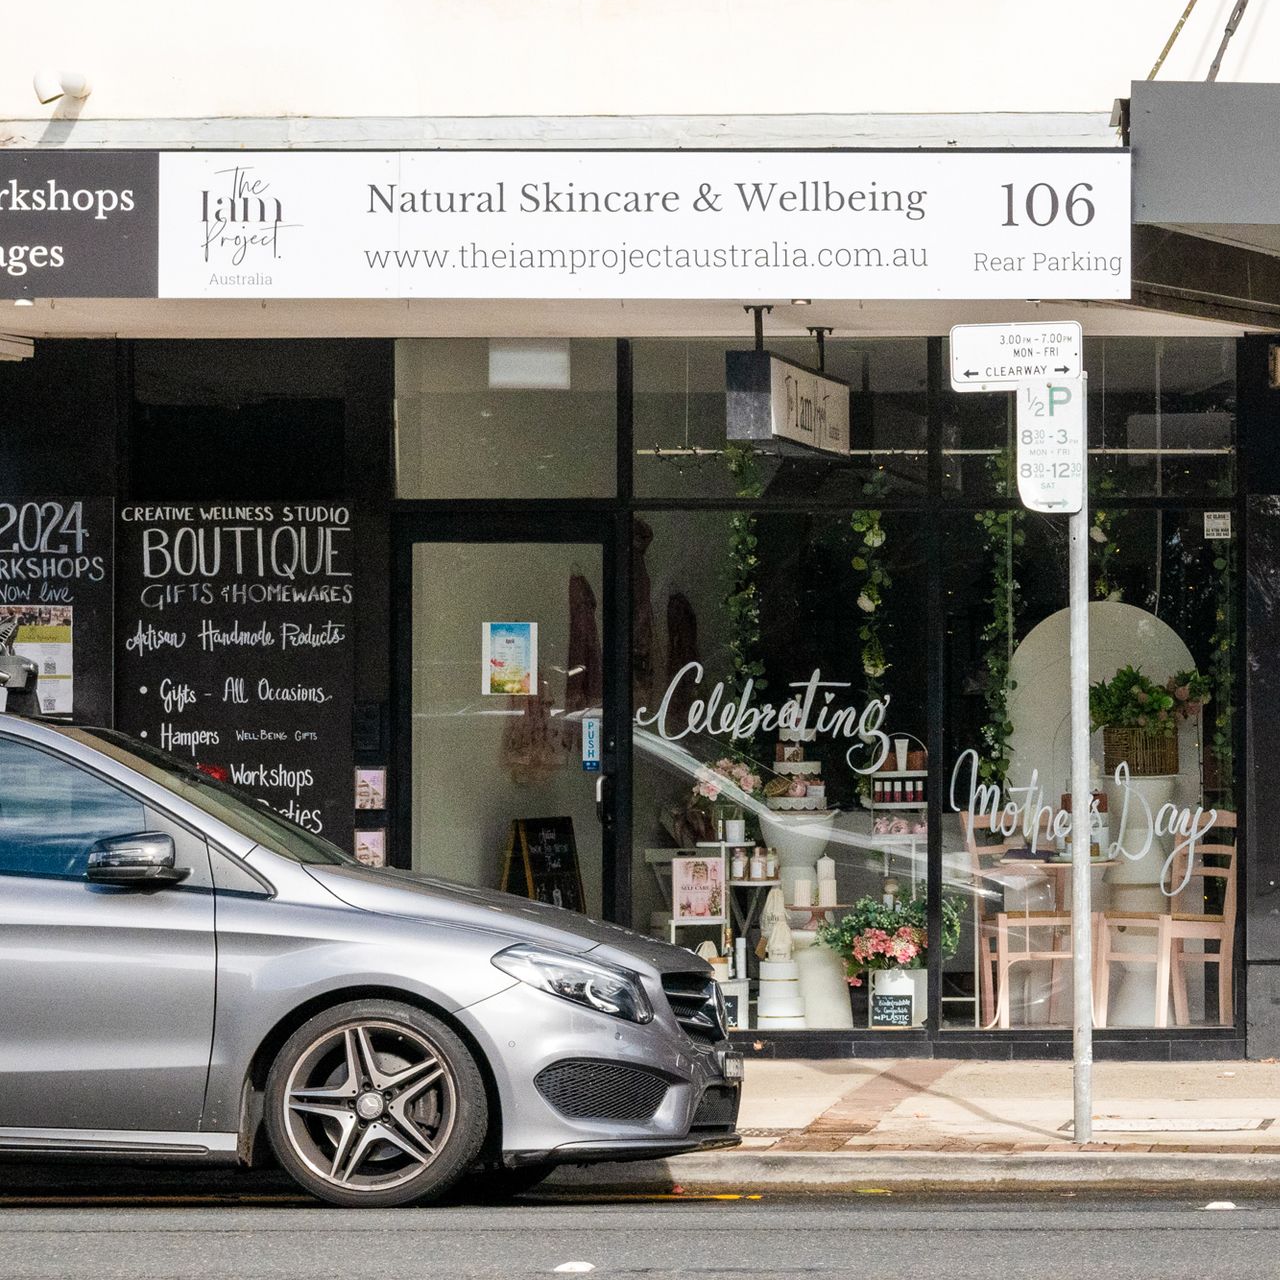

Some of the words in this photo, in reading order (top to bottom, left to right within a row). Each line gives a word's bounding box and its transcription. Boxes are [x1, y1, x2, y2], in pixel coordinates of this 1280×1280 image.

[215, 166, 269, 201] The
[366, 182, 507, 213] Natural
[519, 181, 680, 213] Skincare
[693, 183, 723, 212] &
[734, 181, 928, 221] Wellbeing
[1001, 183, 1096, 227] 106
[364, 241, 928, 275] www.theiamprojectaustralia.com.au
[973, 251, 1025, 272] Rear
[1033, 251, 1122, 276] Parking
[209, 273, 272, 286] Australia
[1013, 347, 1033, 358] MON
[1044, 347, 1059, 357] FRI
[985, 365, 1047, 377] CLEARWAY
[0, 502, 89, 554] 2024
[121, 506, 194, 522] CREATIVE
[200, 506, 274, 521] WELLNESS
[282, 505, 349, 525] STUDIO
[0, 556, 104, 581] RKSHOPS
[143, 526, 352, 580] BOUTIQUE
[39, 582, 74, 602] live
[140, 583, 214, 611] GIFTS
[126, 619, 187, 657] Artisan
[280, 619, 346, 650] Products
[160, 678, 197, 713] Gifts
[222, 677, 249, 704] All
[258, 678, 333, 704] Occasions
[635, 661, 891, 775] Celebrating
[160, 722, 220, 757] Hampers
[587, 721, 595, 758] PUSH
[230, 763, 314, 796] Workshops
[950, 749, 1103, 854] Mothe's
[1108, 760, 1218, 897] Day
